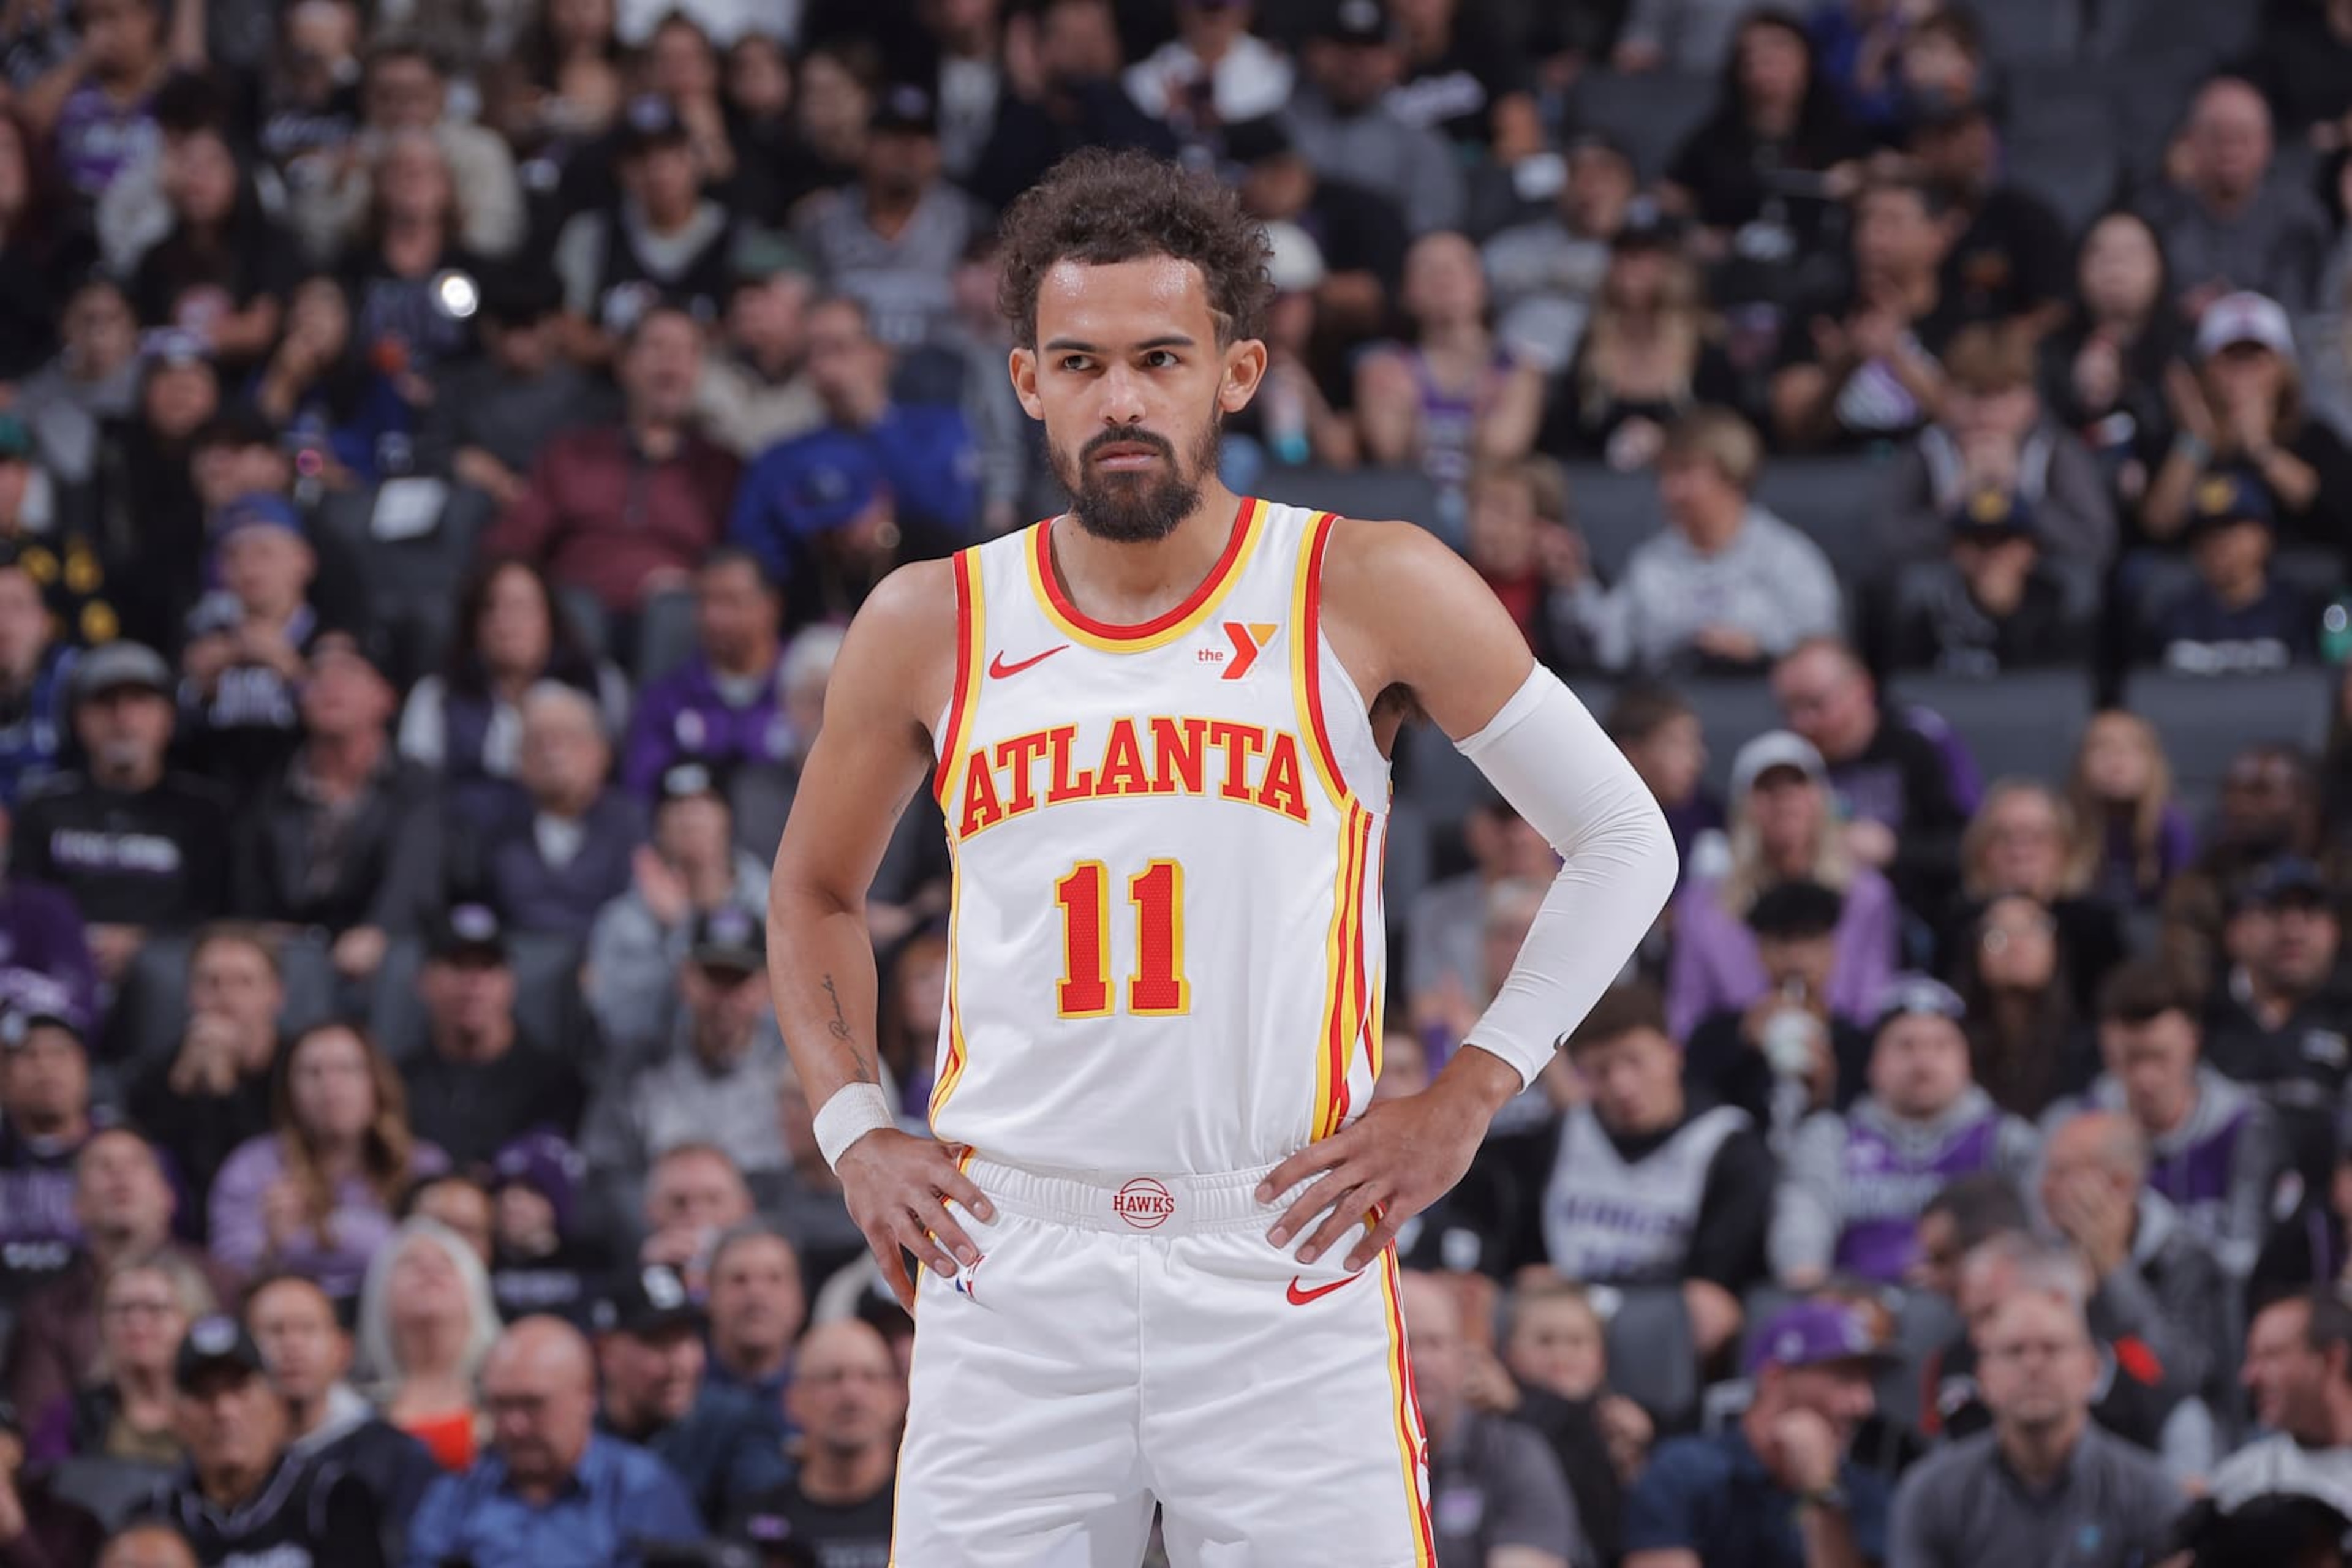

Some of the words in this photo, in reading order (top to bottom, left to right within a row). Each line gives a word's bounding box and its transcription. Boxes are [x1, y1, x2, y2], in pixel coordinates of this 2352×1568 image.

[1197, 648, 1224, 662] the
[958, 717, 1310, 843] ATLANTA
[1055, 858, 1191, 1019] 11
[1113, 1195, 1174, 1213] HAWKS
